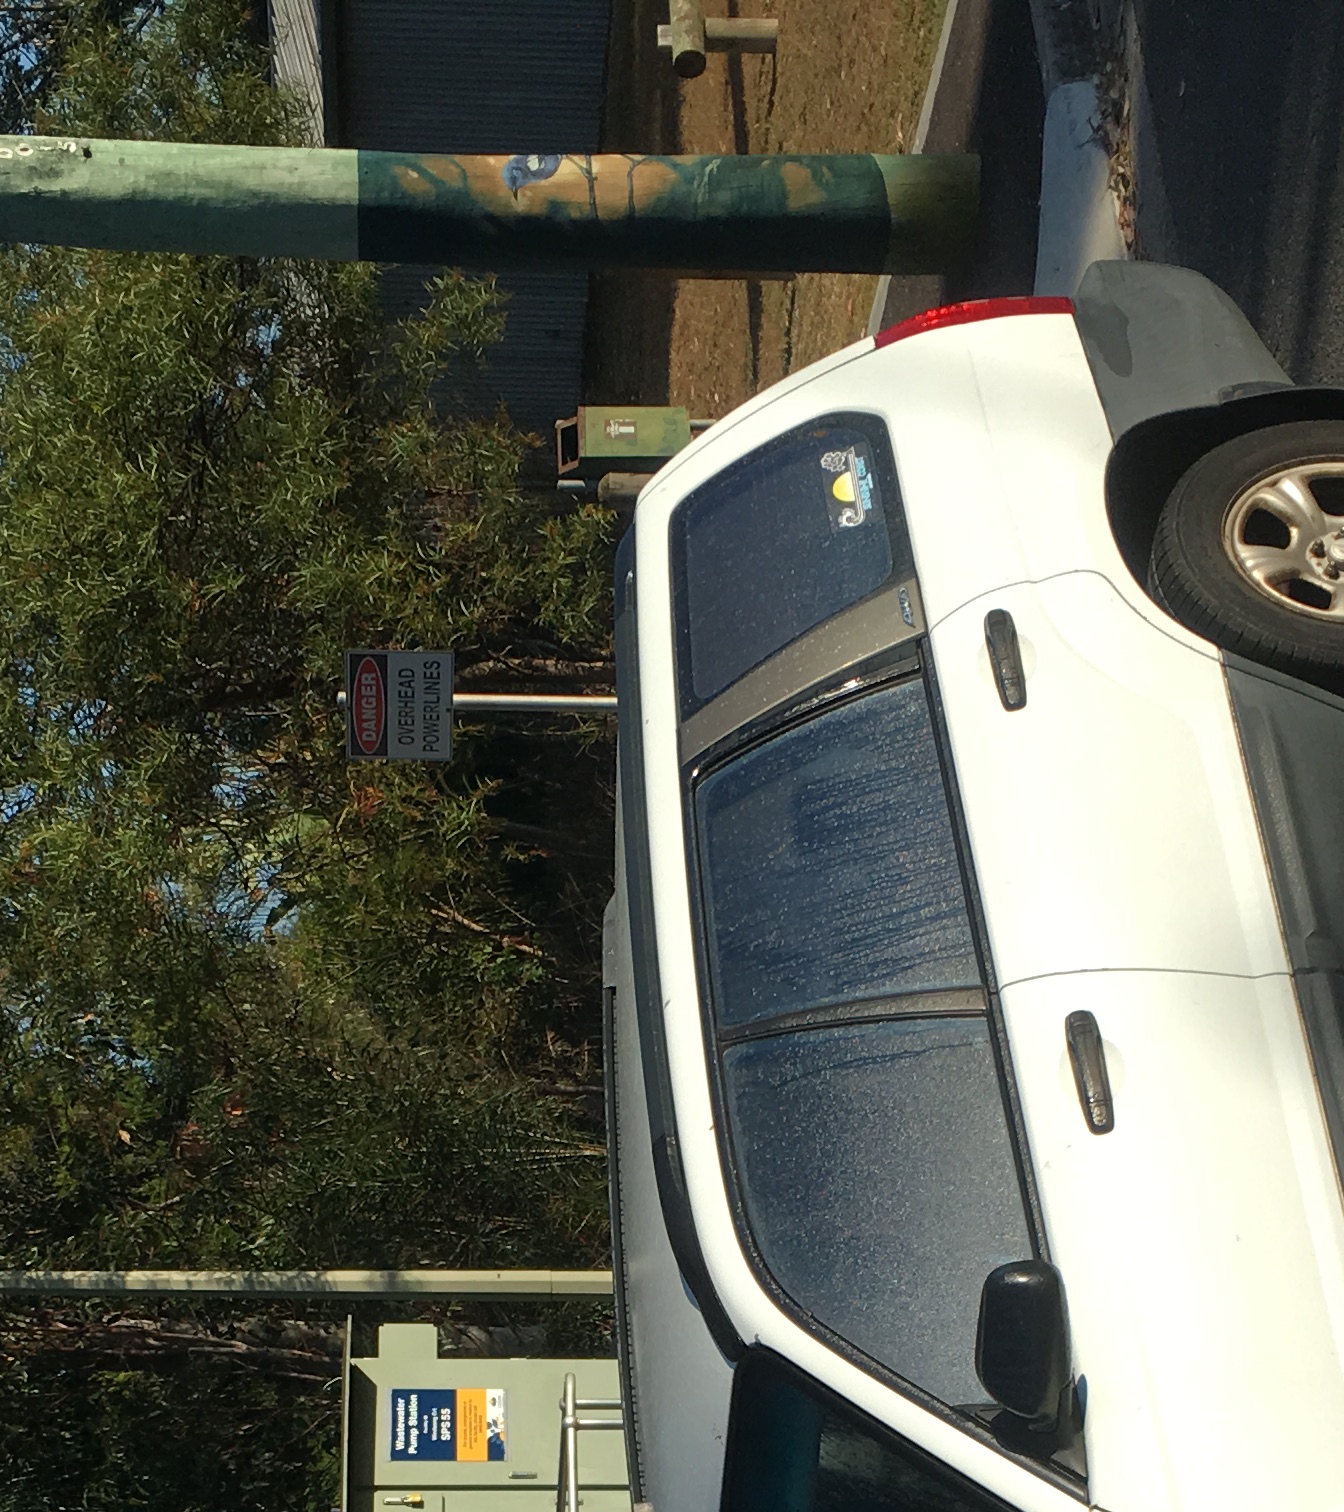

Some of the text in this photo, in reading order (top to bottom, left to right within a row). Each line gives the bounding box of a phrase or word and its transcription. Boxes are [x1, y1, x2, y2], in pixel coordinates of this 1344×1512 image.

[360, 672, 377, 741] DANGER
[397, 668, 415, 746] OVERHEAD
[422, 660, 441, 753] POWERLINES
[395, 1397, 405, 1451] Wastewater
[407, 1394, 419, 1454] Pump Station
[440, 1408, 451, 1441] SPS 55
